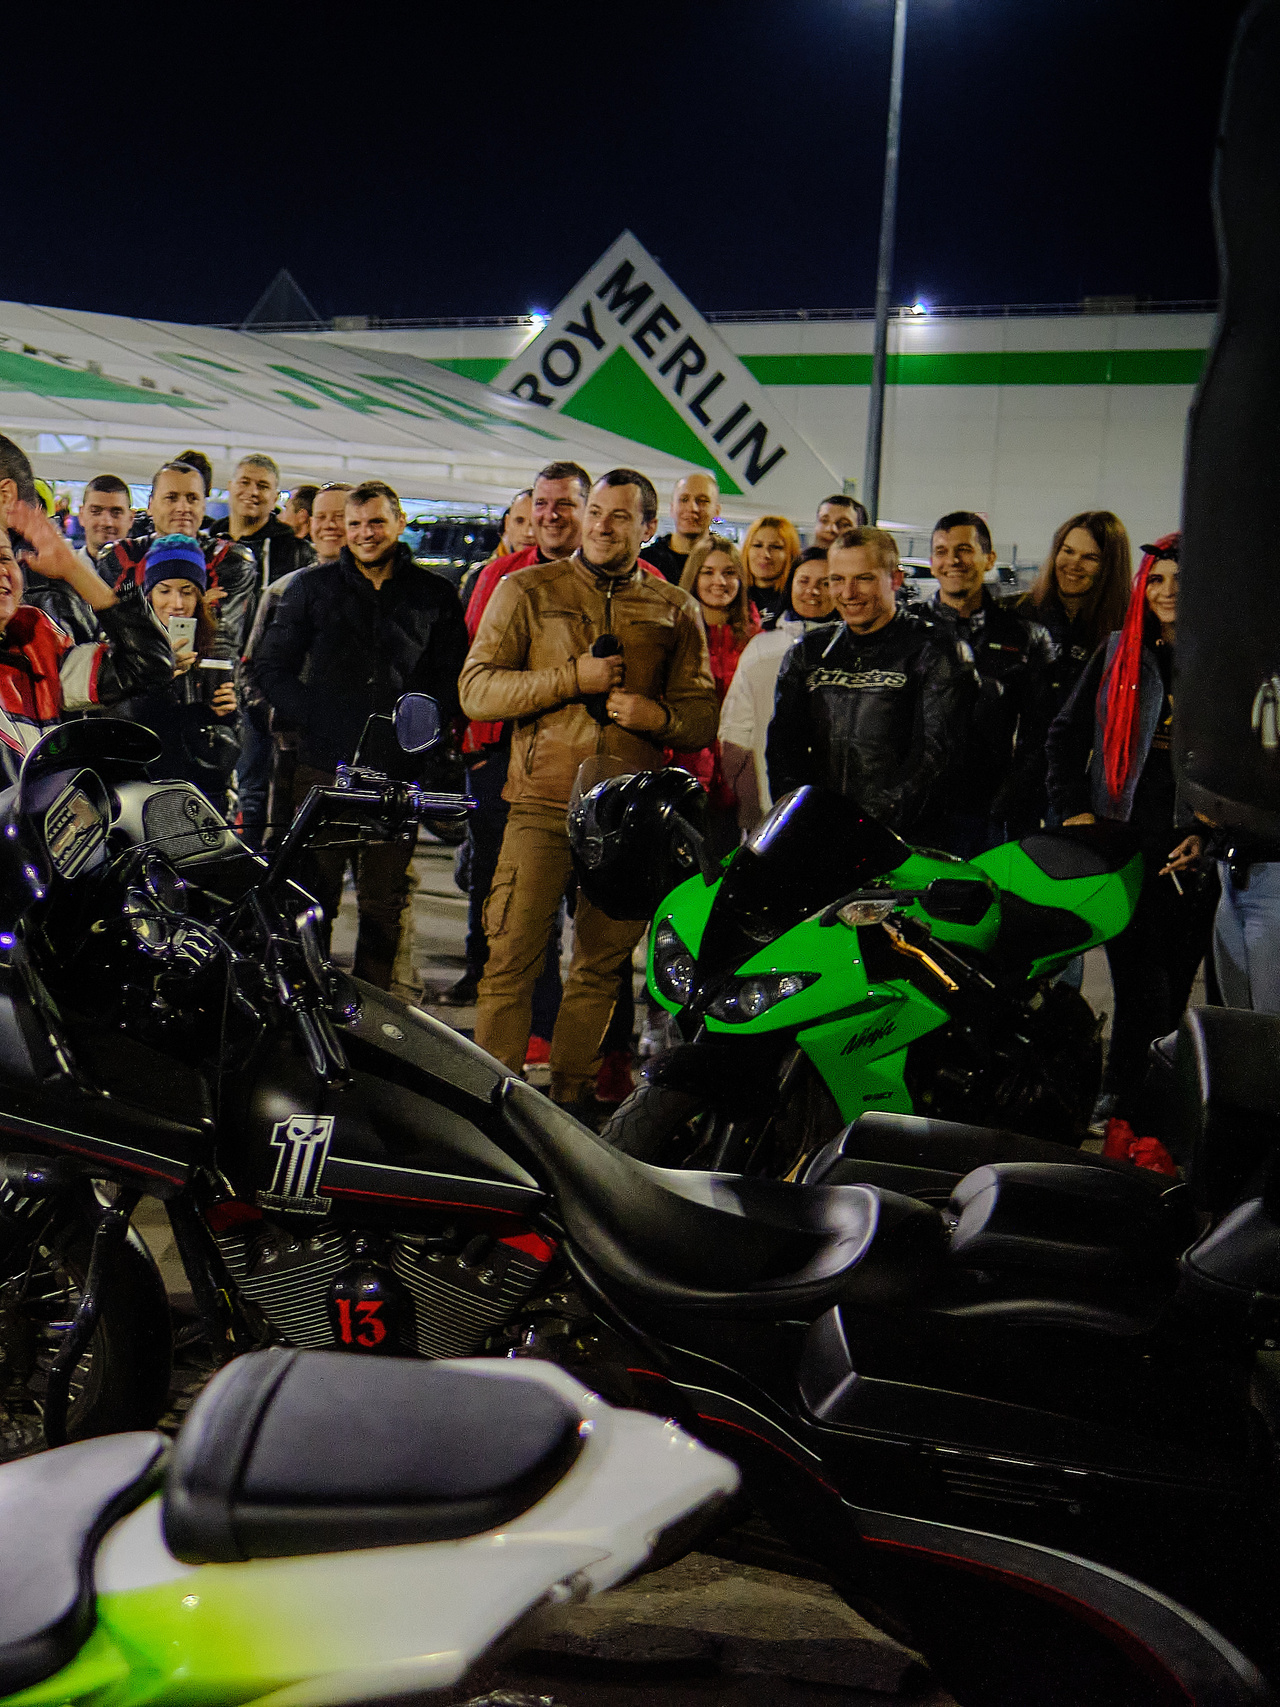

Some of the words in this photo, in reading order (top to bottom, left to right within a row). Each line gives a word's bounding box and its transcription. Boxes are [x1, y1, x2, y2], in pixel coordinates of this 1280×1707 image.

[510, 299, 606, 408] ROY
[595, 259, 787, 486] MERLIN
[335, 1299, 387, 1347] 13
